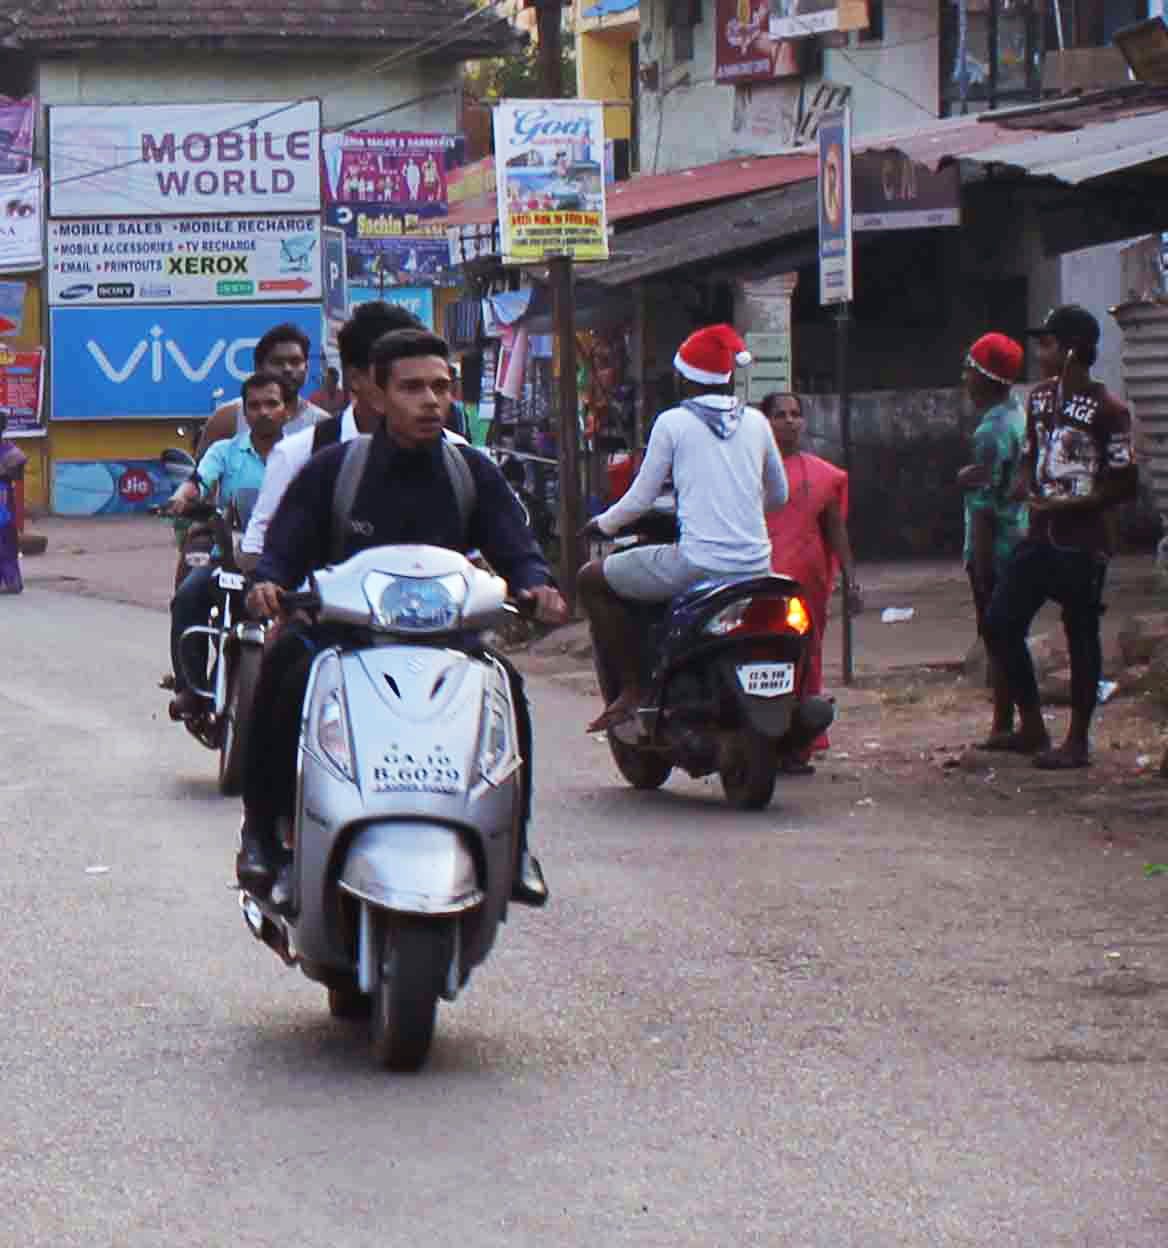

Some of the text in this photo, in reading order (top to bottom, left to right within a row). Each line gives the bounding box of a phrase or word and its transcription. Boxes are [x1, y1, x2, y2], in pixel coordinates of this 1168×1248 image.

[142, 131, 310, 163] MOBILE
[157, 169, 295, 196] WORLD
[60, 217, 315, 236] MOBILE SALES MOBILE RECHARGE
[61, 239, 256, 255] MOBILE ACCESSORIES TV RECHARGE
[61, 255, 248, 275] EMAIL PRINTOUTS XEROX
